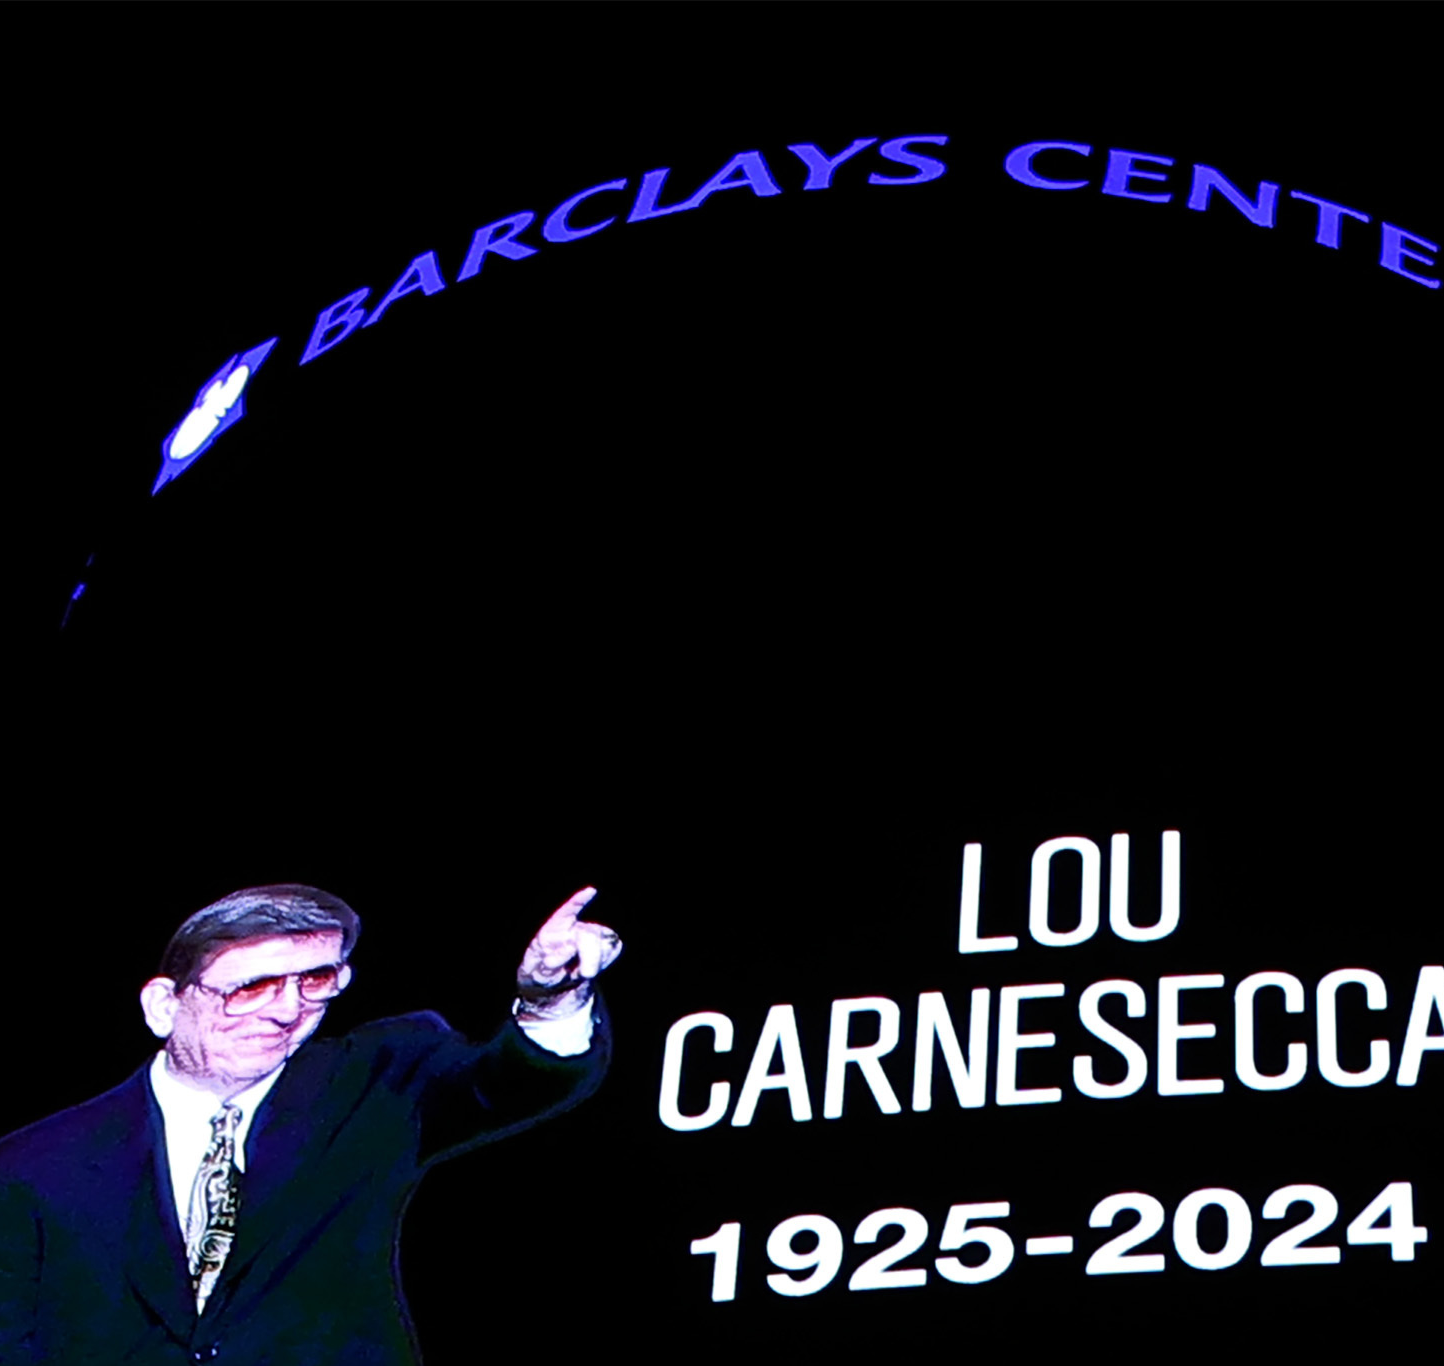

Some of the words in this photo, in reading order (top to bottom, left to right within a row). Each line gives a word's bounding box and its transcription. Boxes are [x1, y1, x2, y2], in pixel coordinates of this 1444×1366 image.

[298, 133, 951, 367] BARCLAYS
[957, 829, 1181, 955] LOU
[689, 1181, 1429, 1303] 1925-2024
